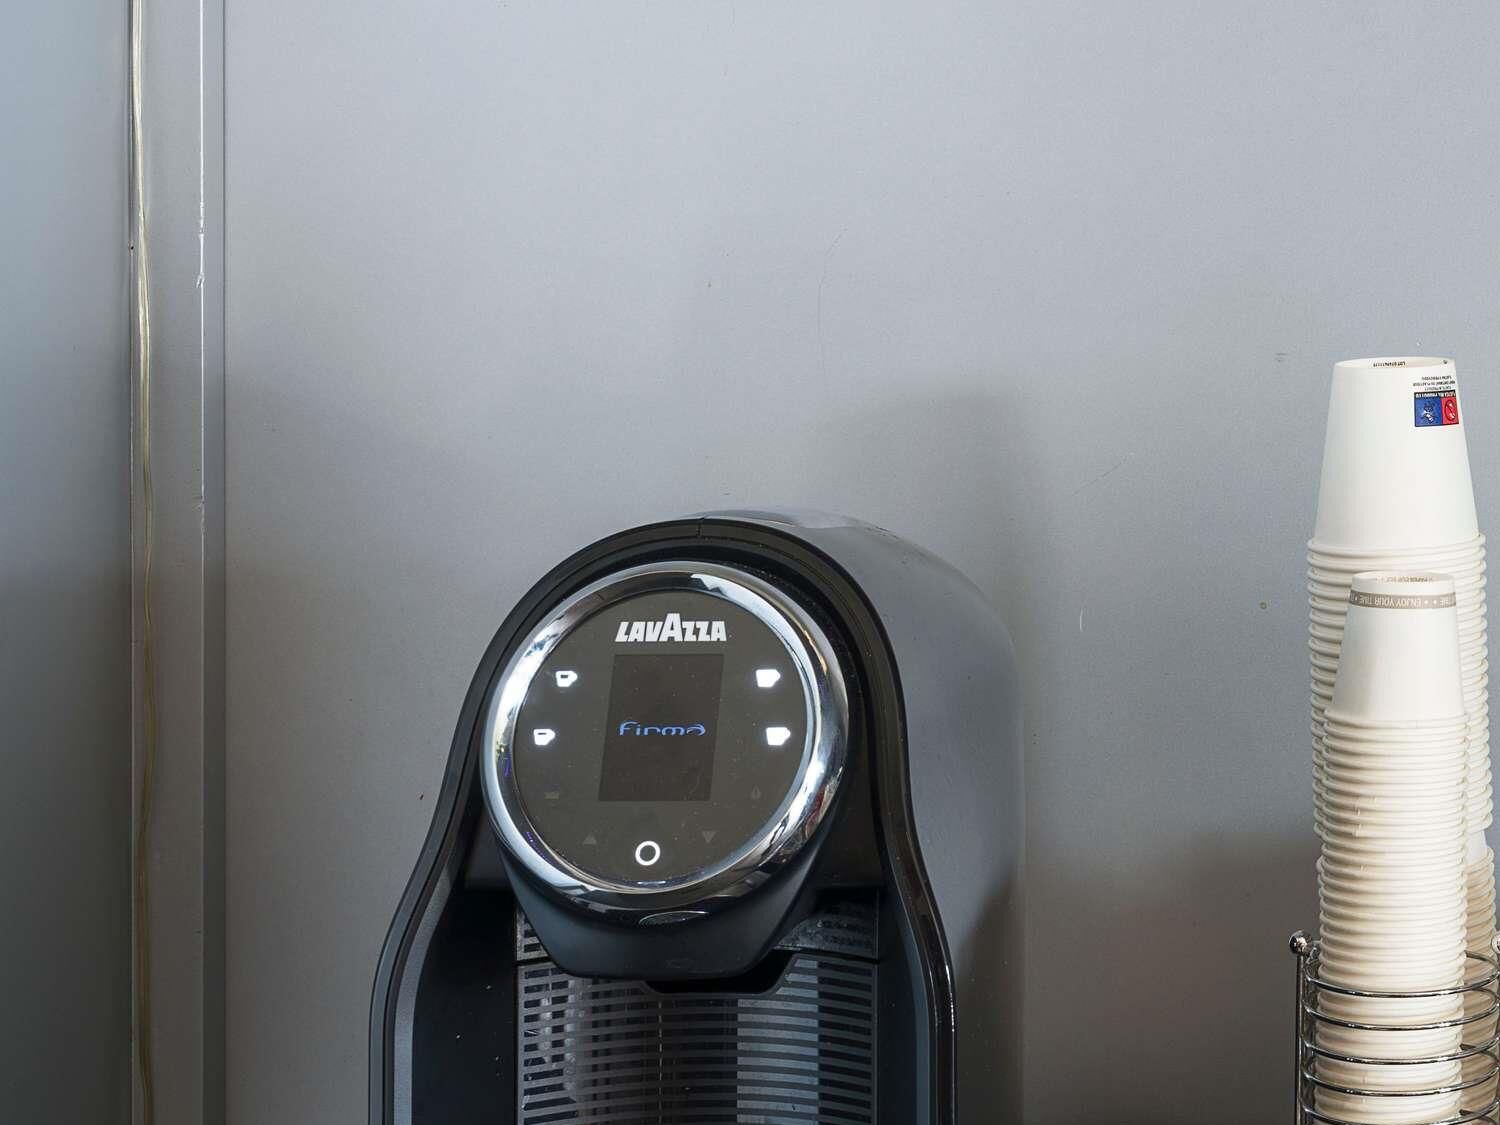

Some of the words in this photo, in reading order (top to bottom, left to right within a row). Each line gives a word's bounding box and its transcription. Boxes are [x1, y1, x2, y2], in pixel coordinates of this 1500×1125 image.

[1374, 597, 1394, 607] YOUR
[1394, 597, 1422, 608] ENJOY
[615, 613, 727, 642] LAVAZZA
